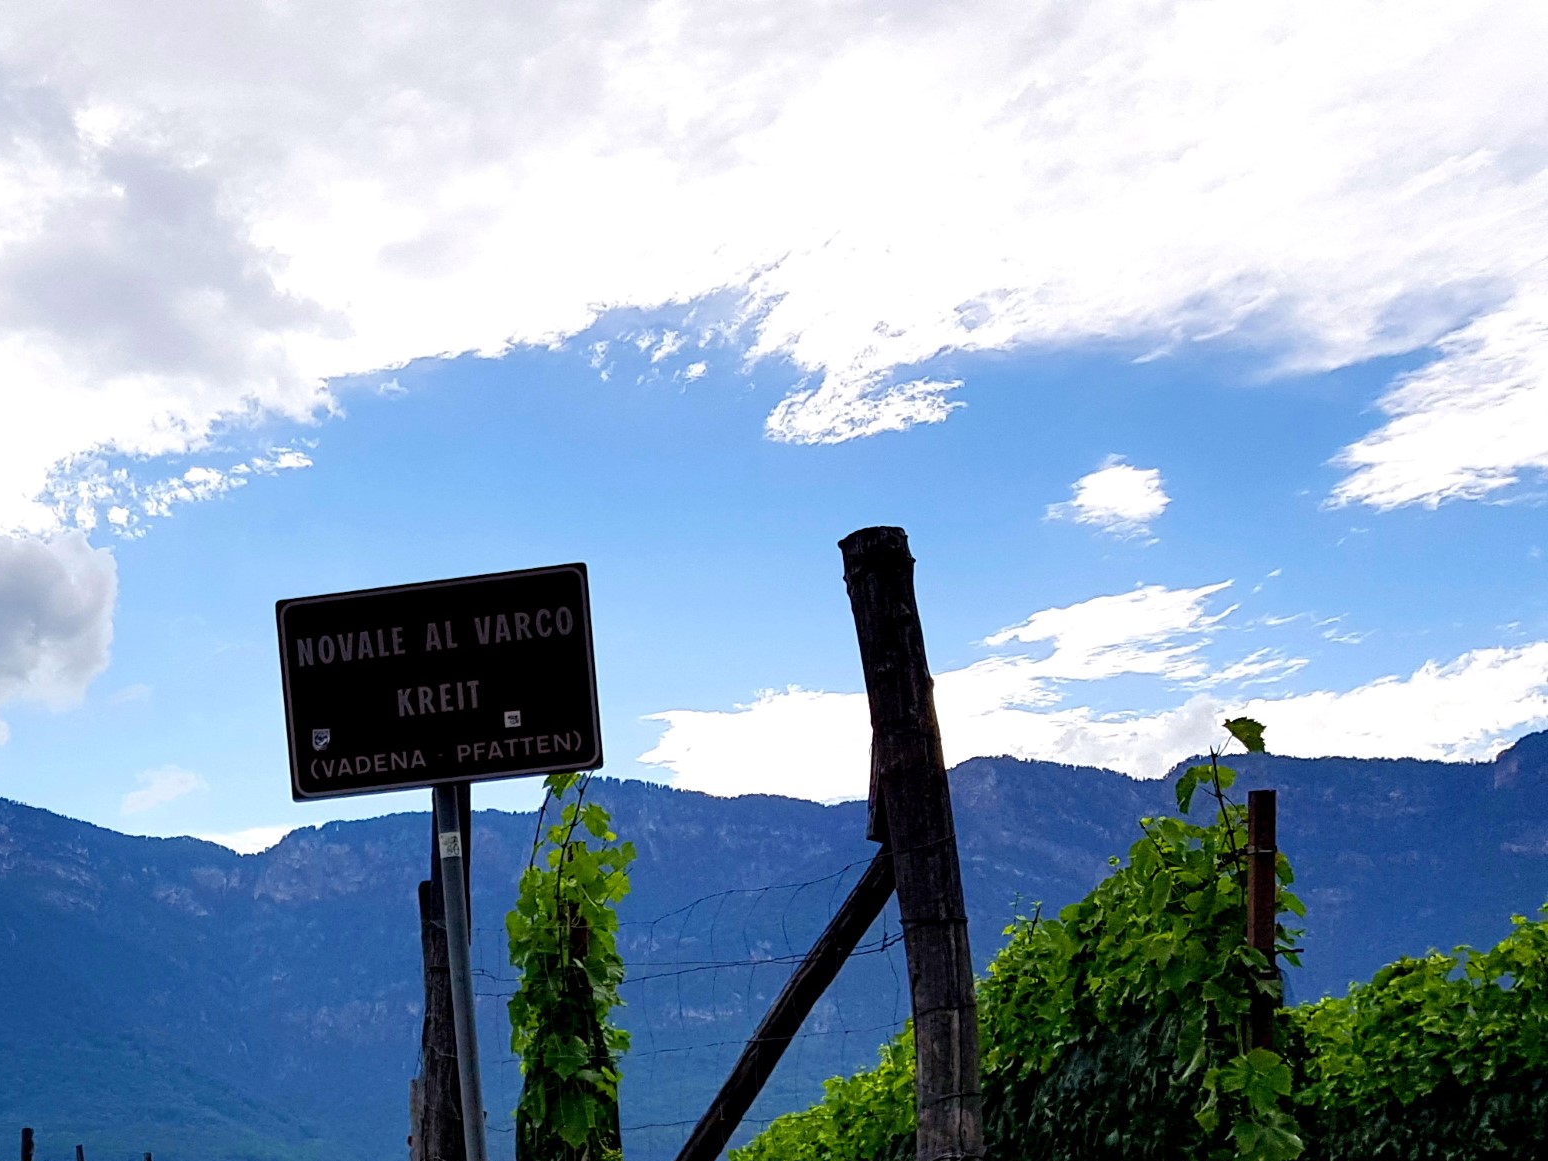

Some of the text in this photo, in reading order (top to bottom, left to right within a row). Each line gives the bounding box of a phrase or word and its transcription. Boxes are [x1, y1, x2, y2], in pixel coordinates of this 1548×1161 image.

[295, 605, 574, 667] NOVALE AL VARCO
[397, 679, 480, 718] KREIT
[310, 749, 427, 780] (VADENA
[457, 730, 582, 763] PFATTEN)
